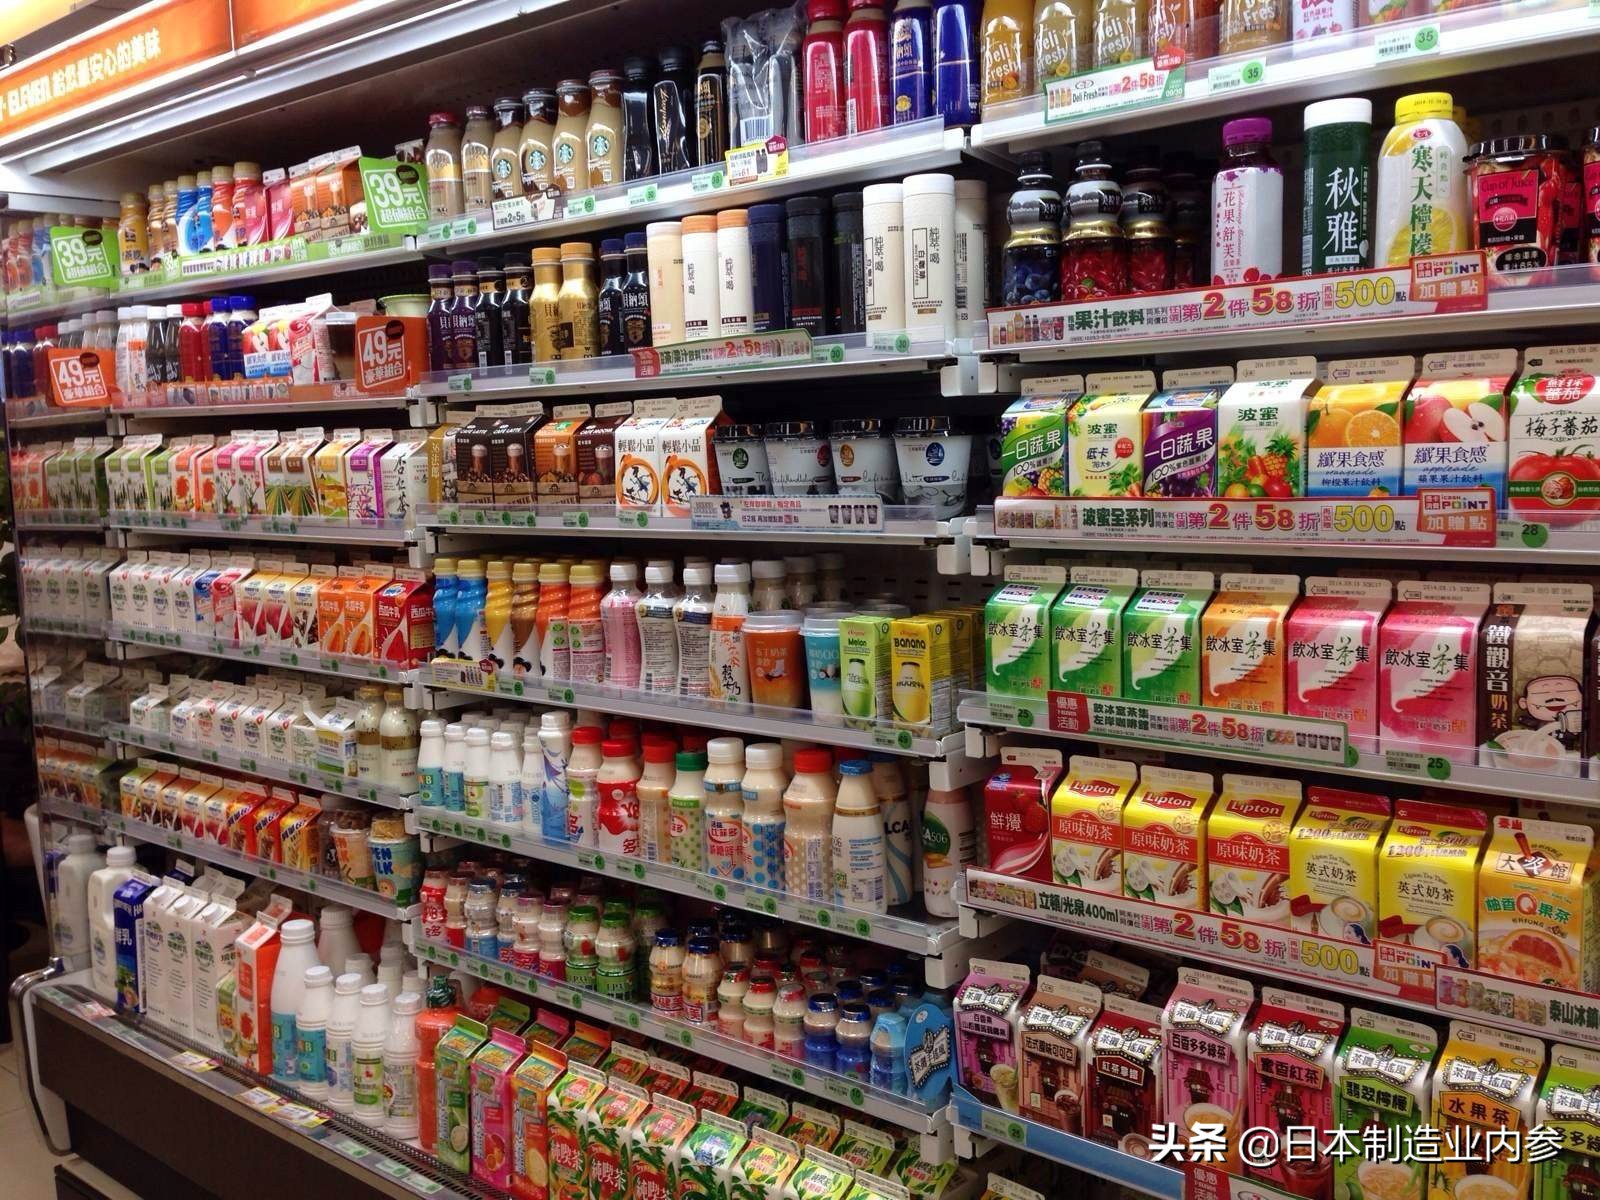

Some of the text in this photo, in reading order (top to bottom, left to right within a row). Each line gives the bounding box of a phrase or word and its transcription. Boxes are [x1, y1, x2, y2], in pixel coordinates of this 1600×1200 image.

[1418, 30, 1435, 44] 35
[1247, 67, 1259, 80] 35
[369, 172, 423, 209] 39元
[1410, 145, 1433, 256] 寒天檸檬
[1322, 166, 1361, 254] 秋雅
[1223, 191, 1236, 259] 花果舒芙
[1419, 279, 1479, 299] 加贈點
[1075, 308, 1145, 330] 果汁飲料
[363, 330, 403, 367] 49元
[57, 363, 101, 389] 49元
[1237, 407, 1279, 422] 波蜜
[1087, 423, 1118, 435] 波蜜
[617, 436, 656, 454] 輕鬆小品
[661, 436, 702, 454] 輕鬆小品
[1001, 429, 1062, 461] 一日蔬果
[1086, 446, 1109, 461] 低卡
[1144, 427, 1213, 461] 一日蔬果
[1413, 445, 1488, 465] 纖果食感
[1317, 451, 1385, 469] 纖果食感
[1082, 507, 1155, 528] 波蜜全系列
[1426, 514, 1489, 532] 加贈點
[1521, 523, 1538, 536] 28
[988, 616, 1045, 643] 飲冰室茶集
[1055, 621, 1115, 648] 飲冰室茶集
[1127, 626, 1193, 655] 飲冰室茶集
[1205, 630, 1276, 660] 飲冰室茶集
[1292, 636, 1370, 666] 飲冰室茶集
[1384, 643, 1470, 675] 飲冰室茶集
[1486, 625, 1512, 729] 鐵觀音奶茶
[1017, 709, 1030, 720] 25
[1427, 757, 1444, 769] 25
[1073, 780, 1116, 795] Lipton
[1146, 792, 1192, 808] Lipton
[1230, 800, 1281, 816] Lipton
[1058, 818, 1113, 842] 原味奶茶
[1130, 830, 1190, 856] 原味奶茶
[1216, 841, 1282, 867] 原味奶茶
[1305, 861, 1358, 884] 英式奶茶
[1399, 881, 1455, 902] 英式奶茶
[1448, 1097, 1512, 1127] 水果茶
[551, 1142, 583, 1172] 純喫茶
[591, 1157, 626, 1192] 純喫茶
